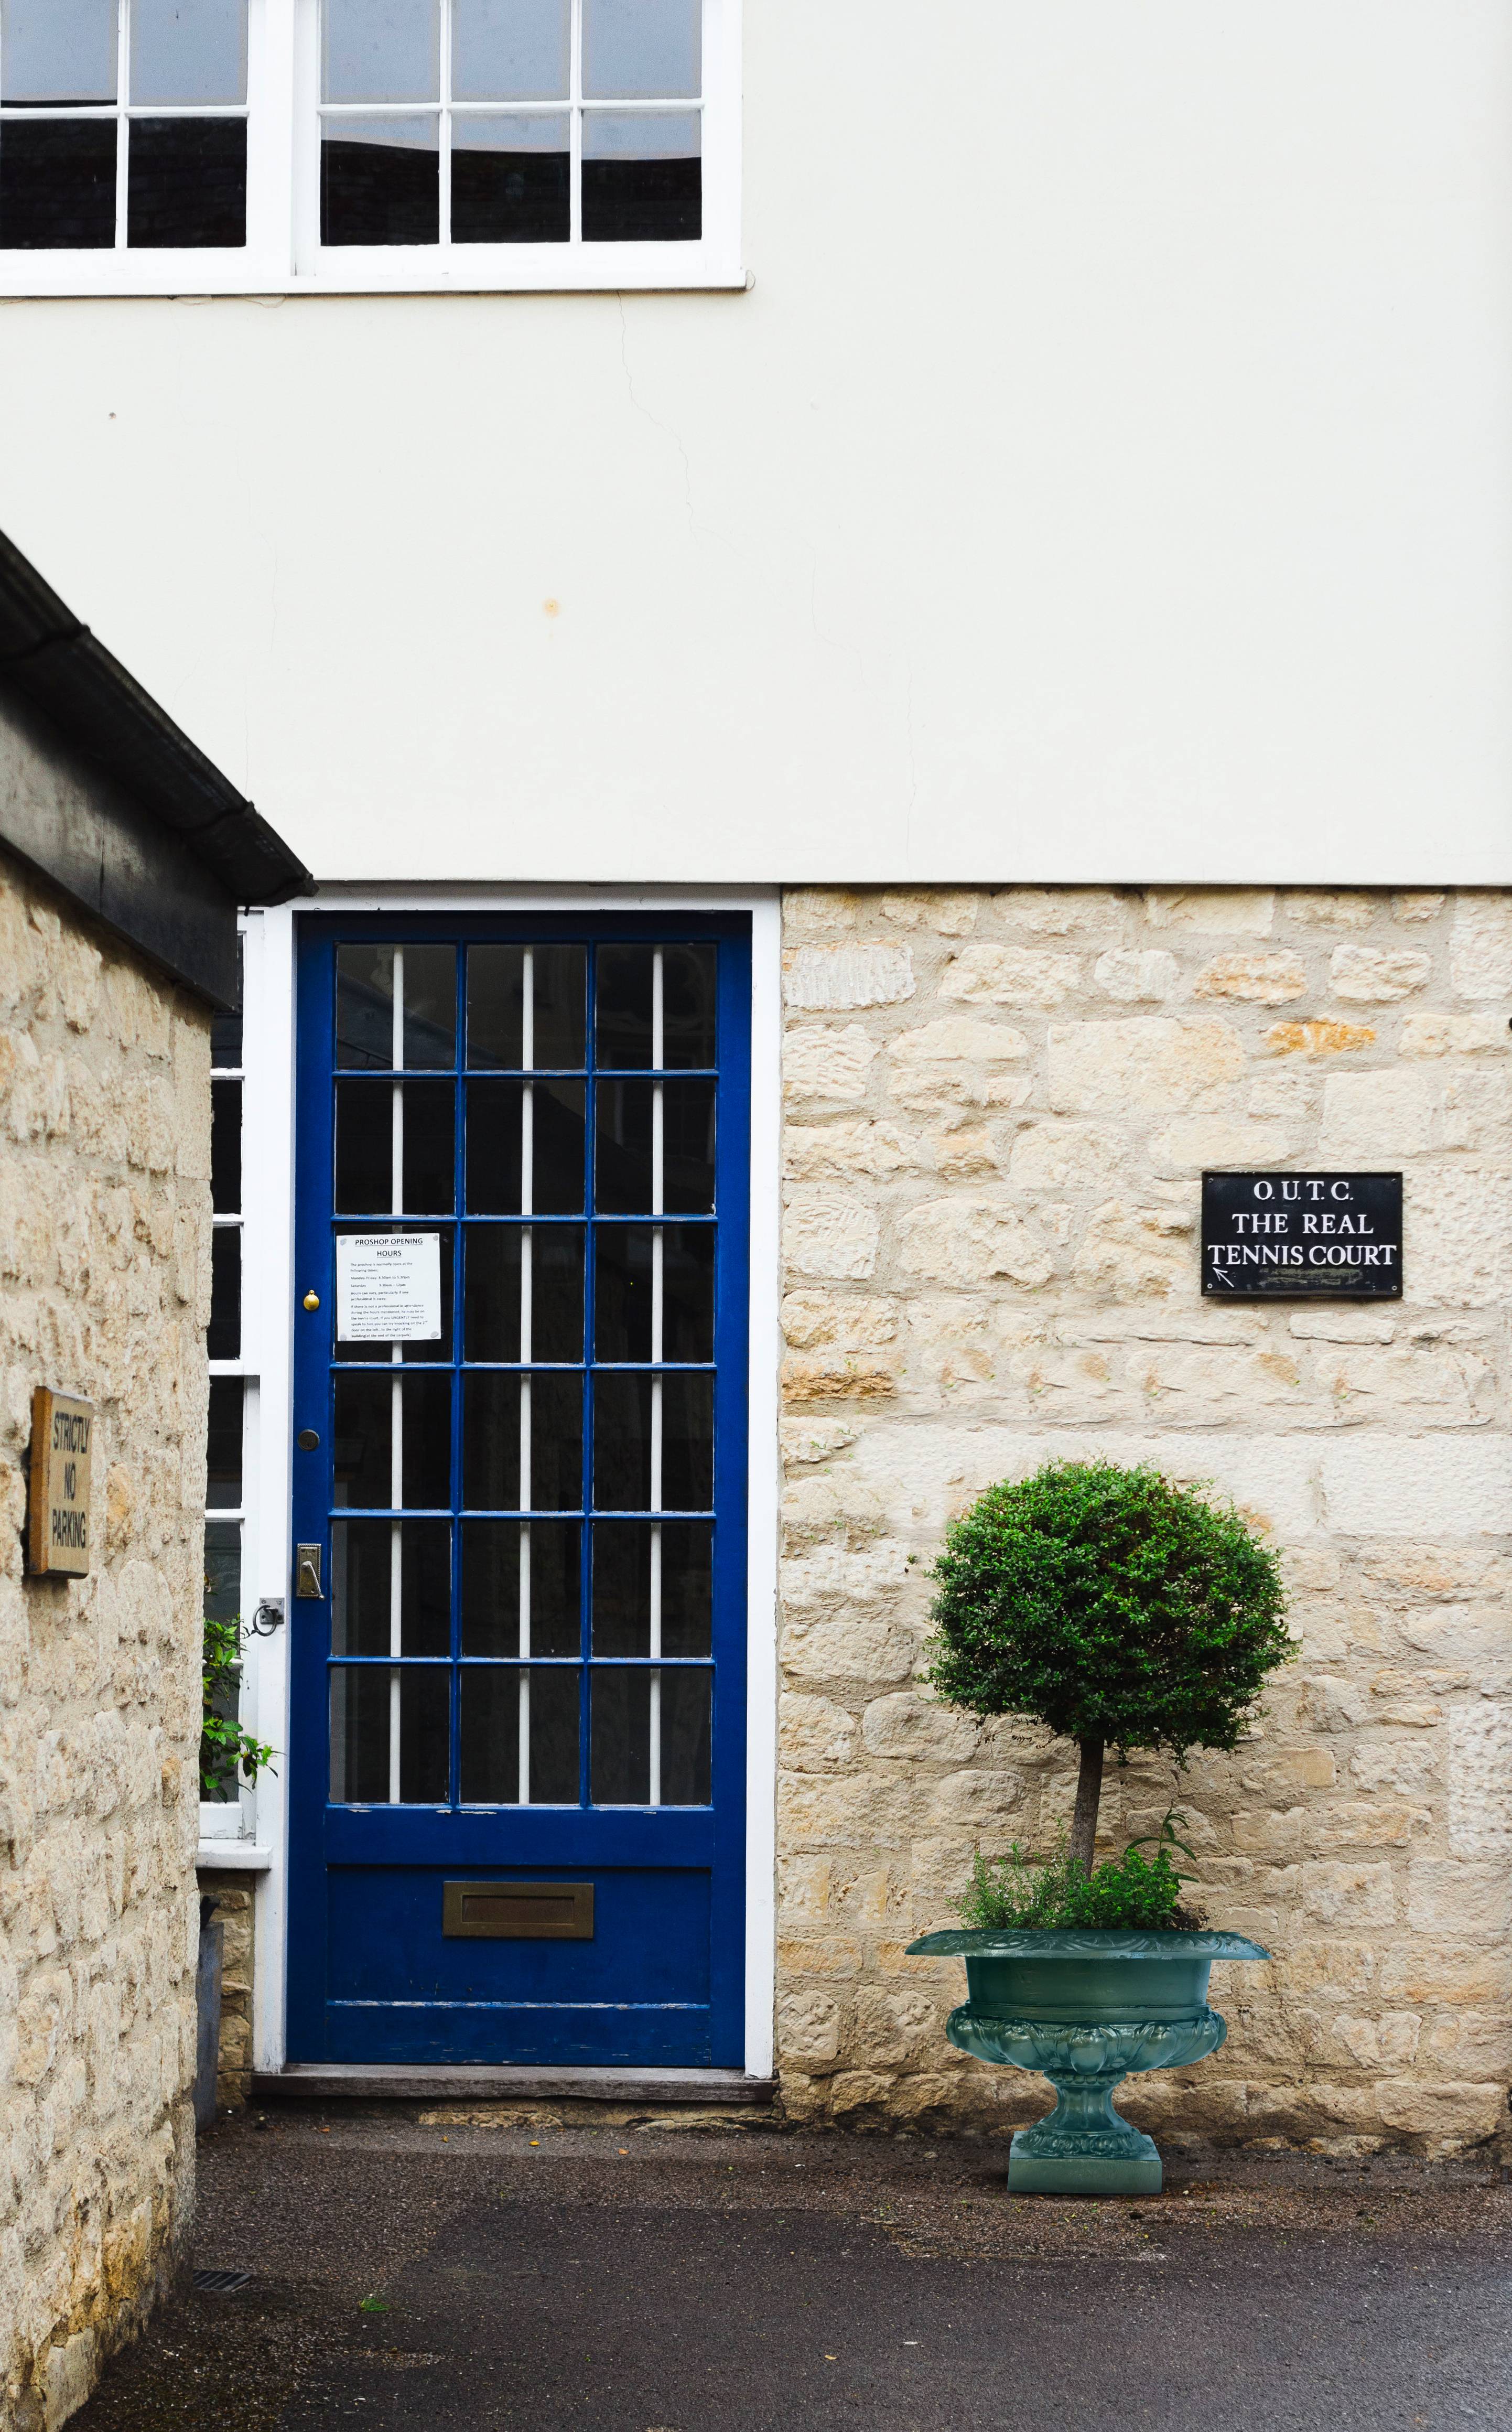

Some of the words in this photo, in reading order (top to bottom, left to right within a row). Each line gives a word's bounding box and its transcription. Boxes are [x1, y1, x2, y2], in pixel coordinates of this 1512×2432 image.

[1232, 1214, 1288, 1233] THE
[1302, 1214, 1374, 1234] REAL
[1208, 1245, 1303, 1265] TENNIS
[1309, 1245, 1397, 1265] COURT
[53, 1411, 90, 1454] STRICTLY
[64, 1461, 76, 1501] NO
[52, 1509, 87, 1549] PARKING
